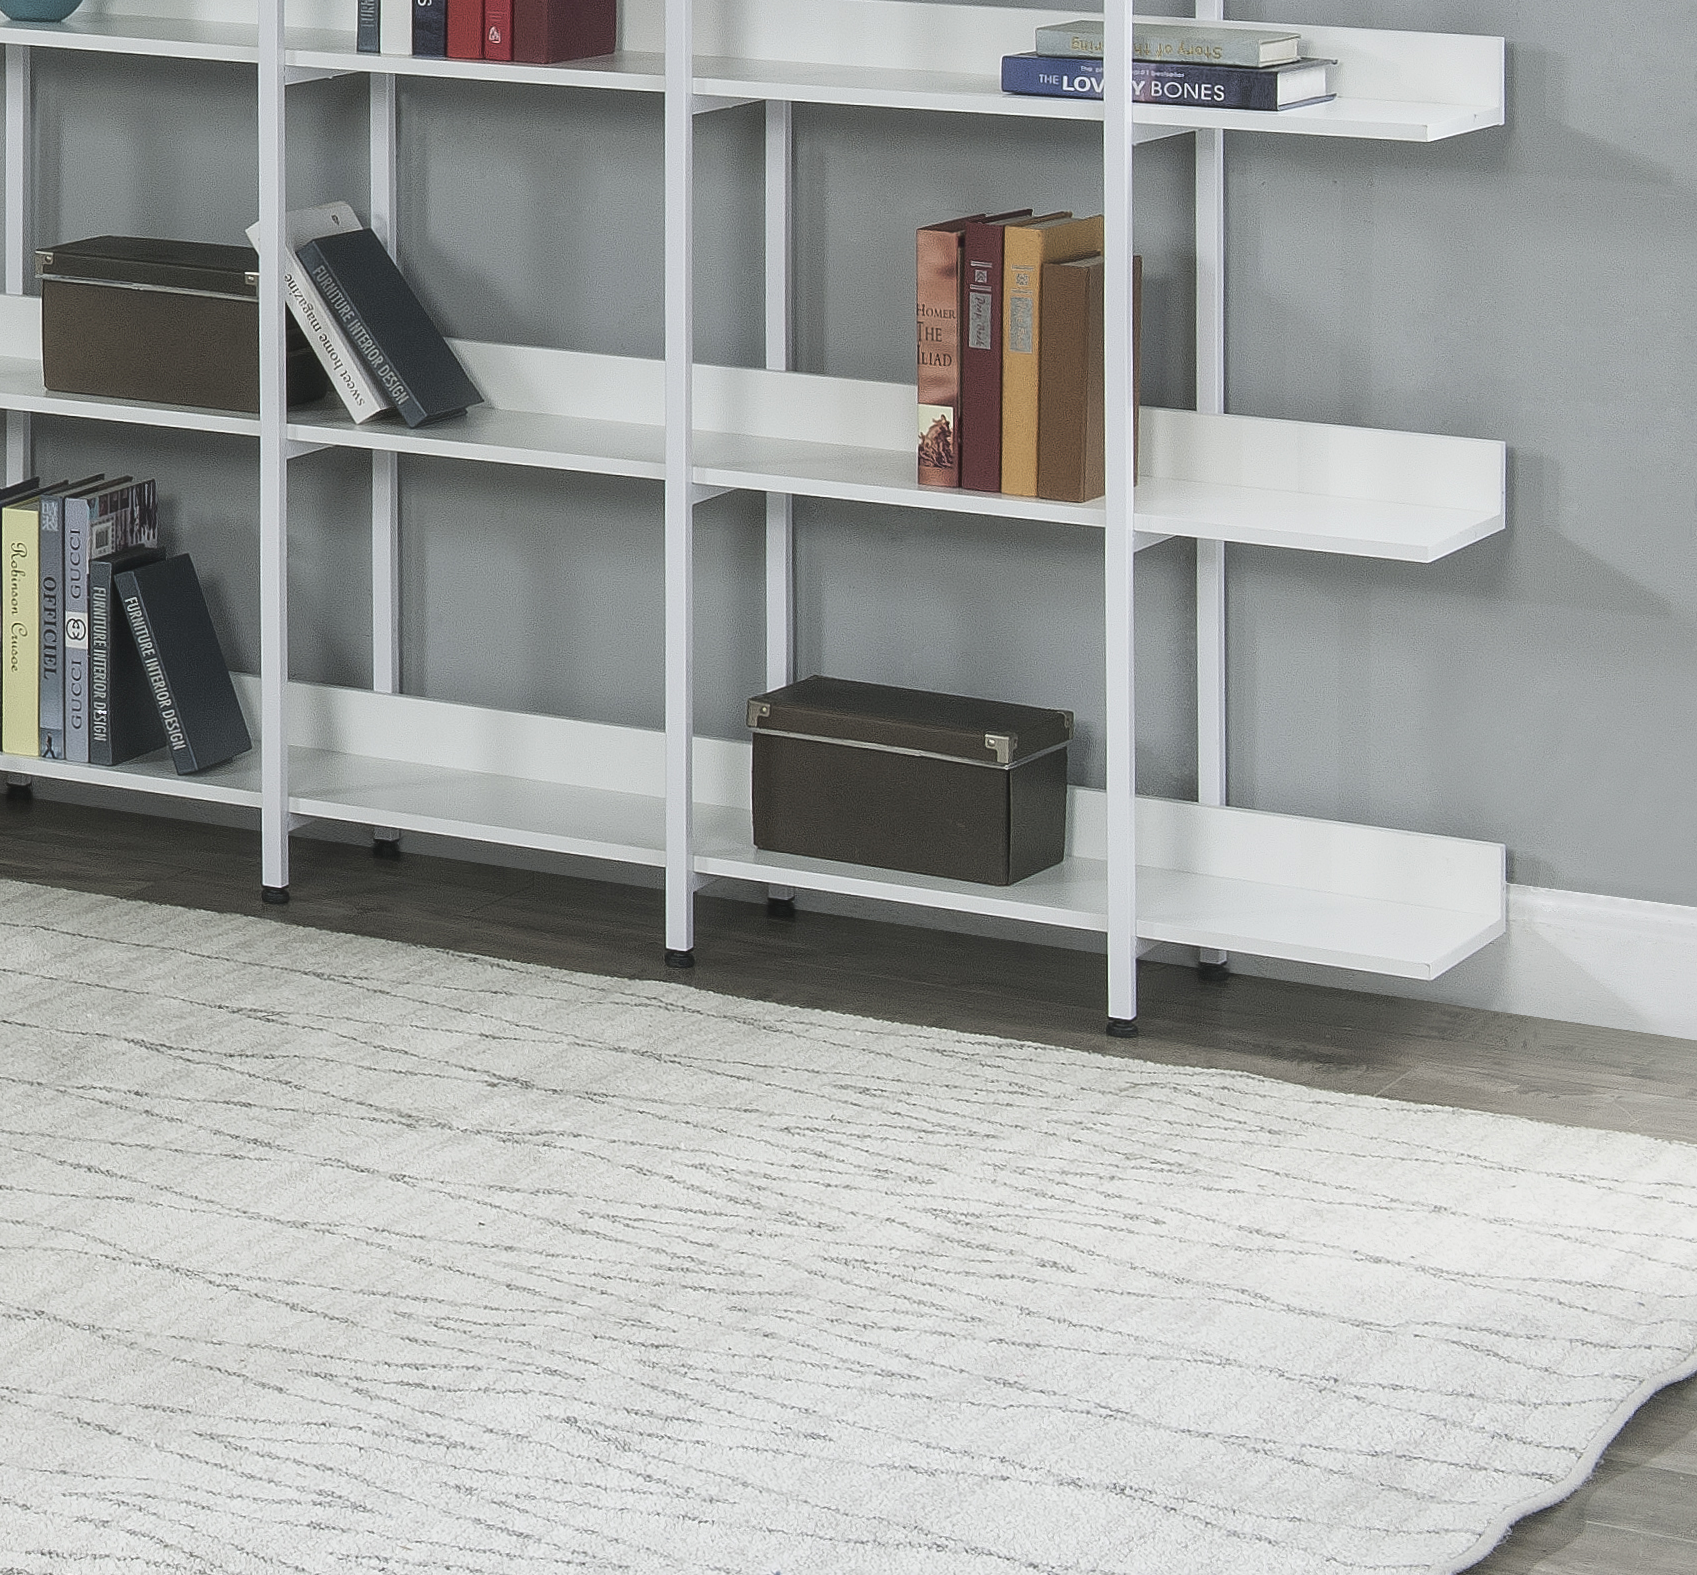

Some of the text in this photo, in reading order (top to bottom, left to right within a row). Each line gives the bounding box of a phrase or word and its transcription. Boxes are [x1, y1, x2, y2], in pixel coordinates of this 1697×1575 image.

[1156, 42, 1172, 58] of
[1178, 40, 1223, 59] Story
[1038, 74, 1225, 102] THE LOVY BONES
[284, 273, 365, 407] sweet home magazine
[312, 265, 409, 405] FURNITURE INTERIOR DESIGN
[916, 303, 956, 319] HOMER
[917, 321, 943, 342] THE
[917, 344, 952, 367] ILIAD
[70, 529, 82, 599] GUCCI
[10, 542, 28, 673] Robinson Crusoe
[42, 576, 57, 680] OFFICIEL
[71, 660, 83, 730] GUCCI
[93, 586, 107, 742] FURNITURE INTERIOR DESIGN
[125, 596, 187, 750] FURNITURE INTERIOR DESIGN
